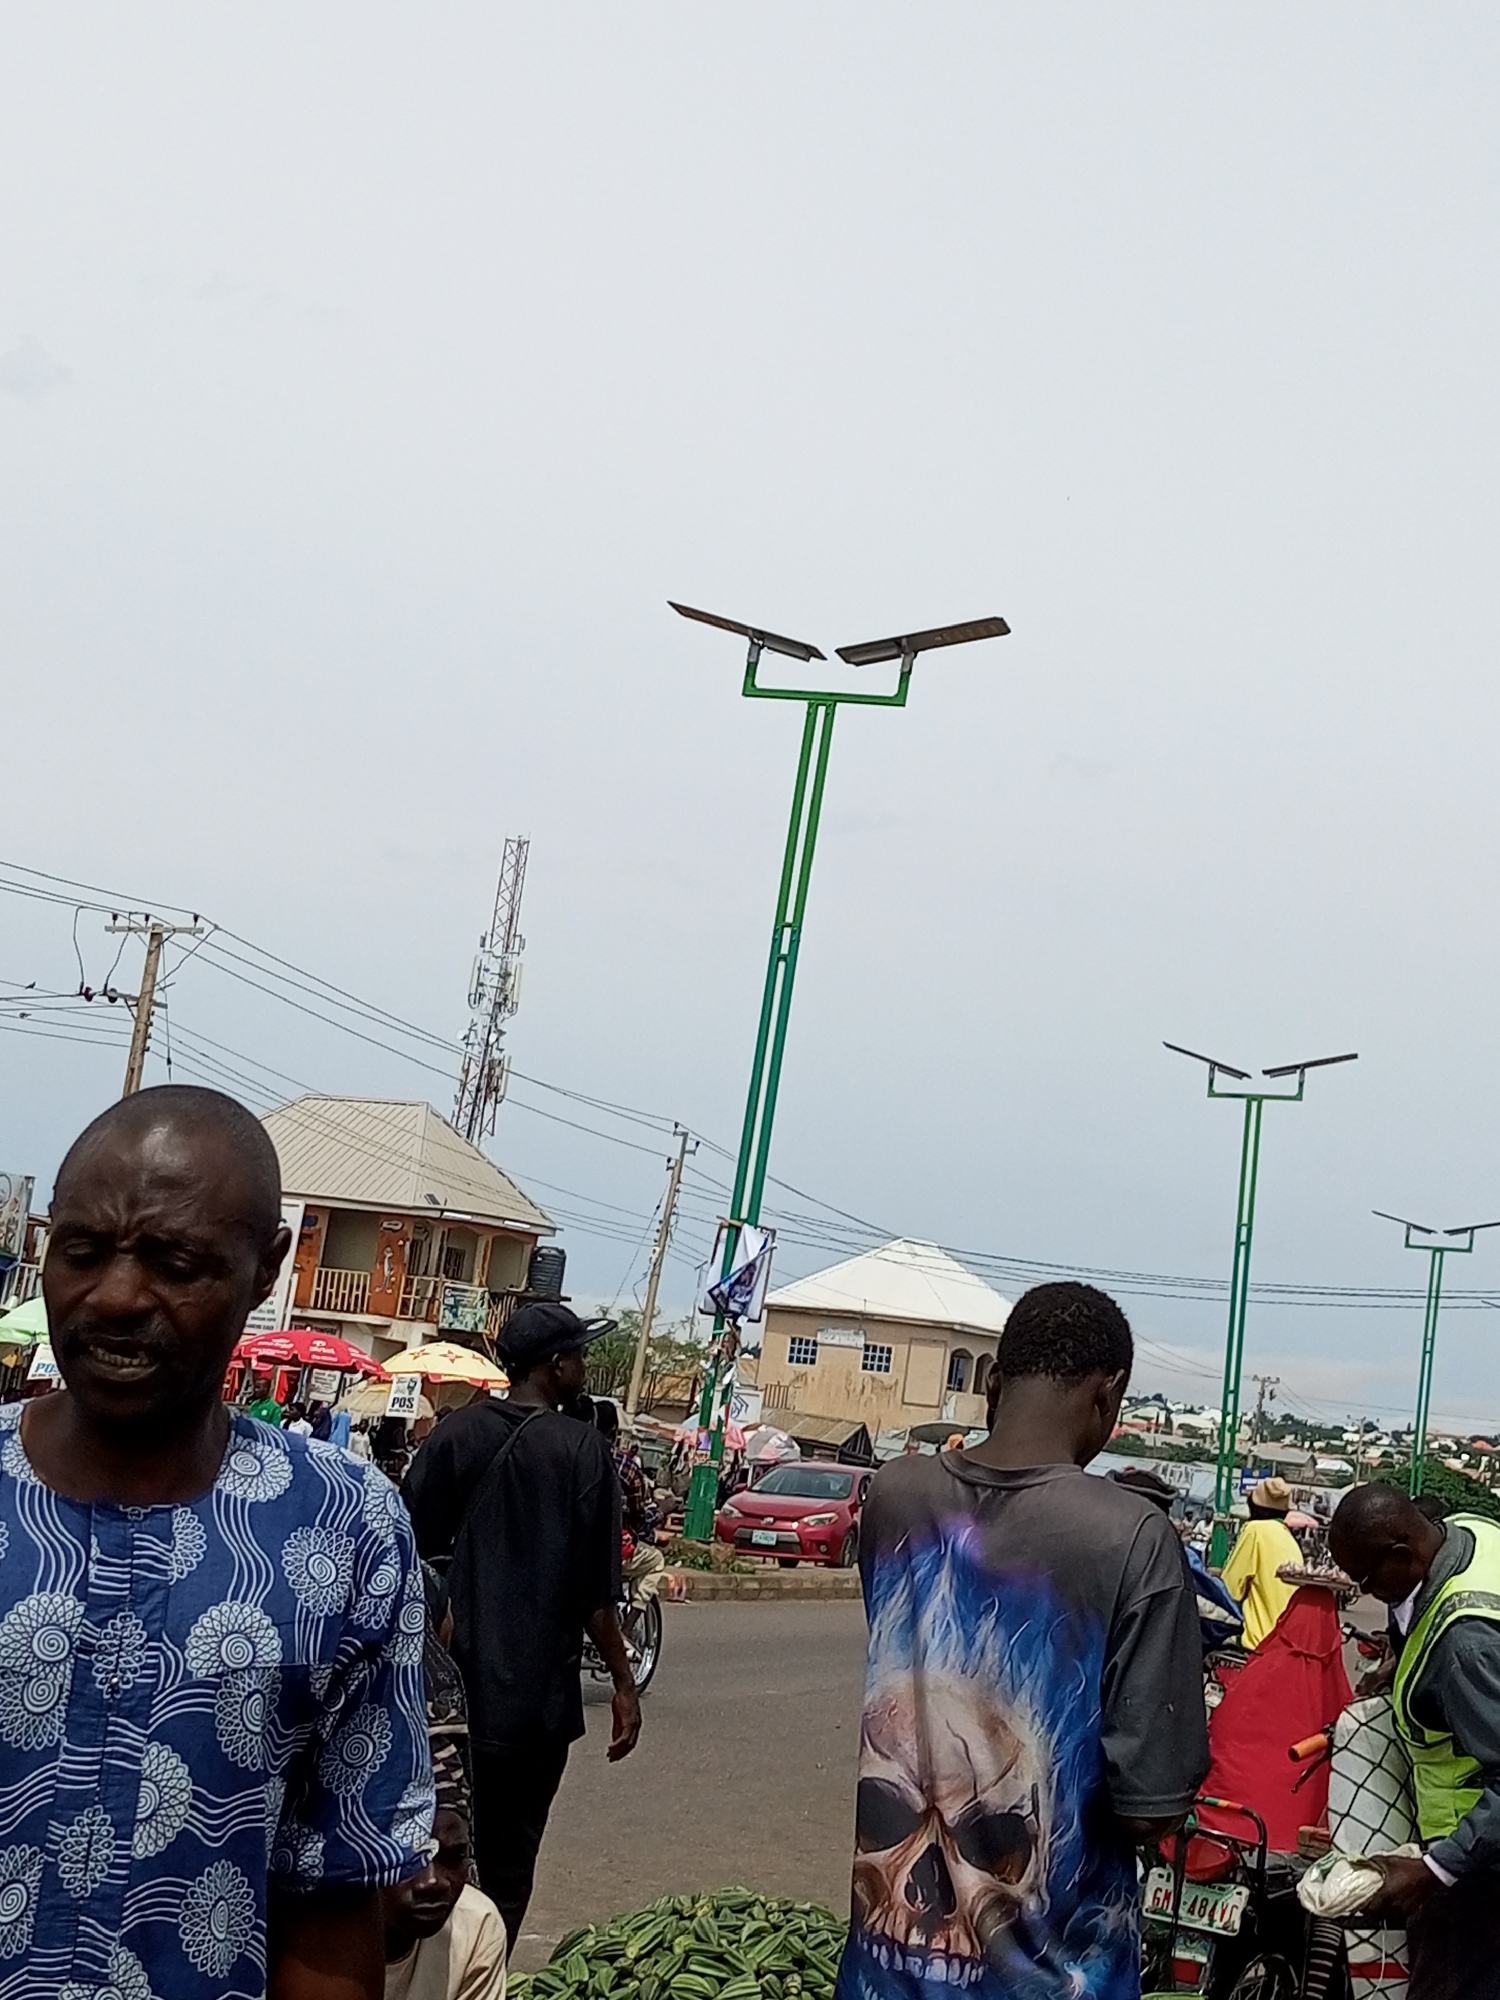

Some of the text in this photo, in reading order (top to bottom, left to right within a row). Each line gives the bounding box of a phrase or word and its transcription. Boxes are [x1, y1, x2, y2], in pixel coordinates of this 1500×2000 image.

[34, 1362, 58, 1374] PO
[391, 1396, 415, 1409] POS
[1152, 1886, 1175, 1914] GM
